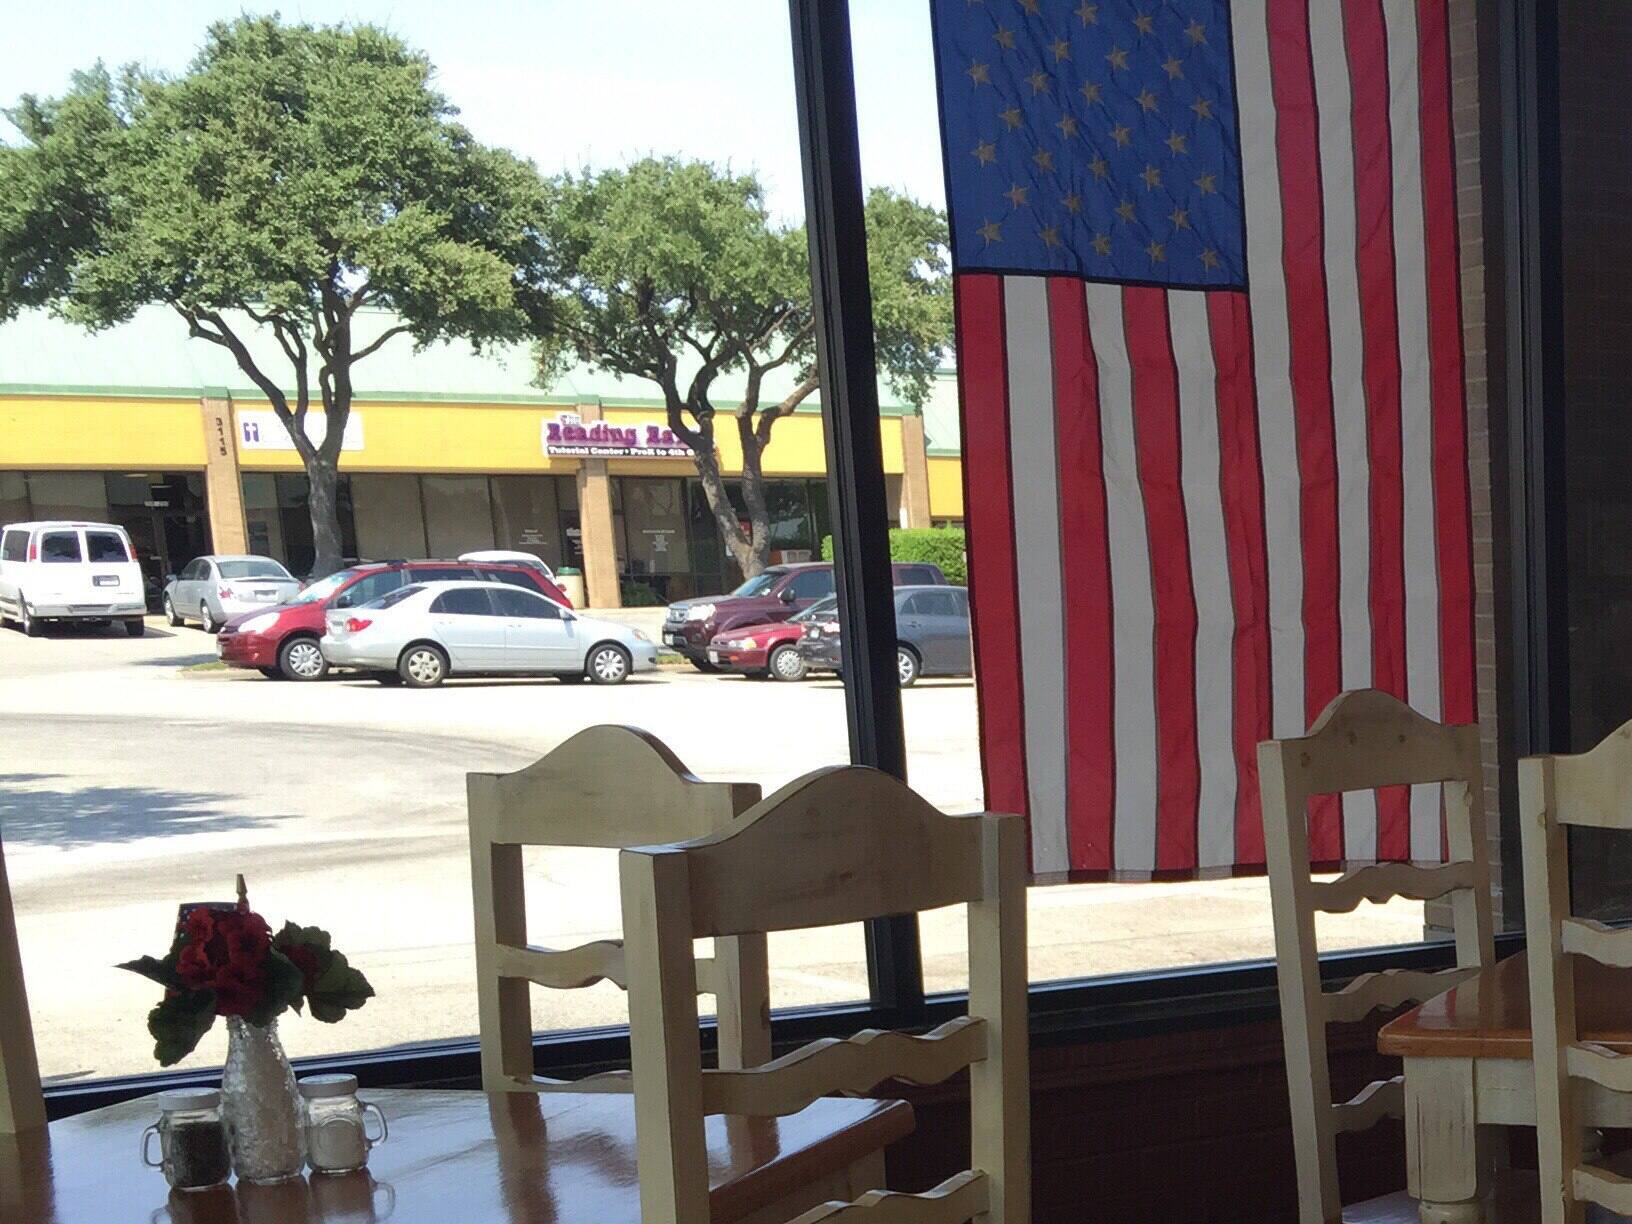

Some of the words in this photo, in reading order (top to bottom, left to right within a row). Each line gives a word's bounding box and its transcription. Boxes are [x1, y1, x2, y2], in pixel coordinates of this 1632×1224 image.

[547, 422, 637, 447] Reading
[548, 446, 589, 455] Tutorial
[590, 447, 624, 456] Center
[656, 448, 667, 456] to
